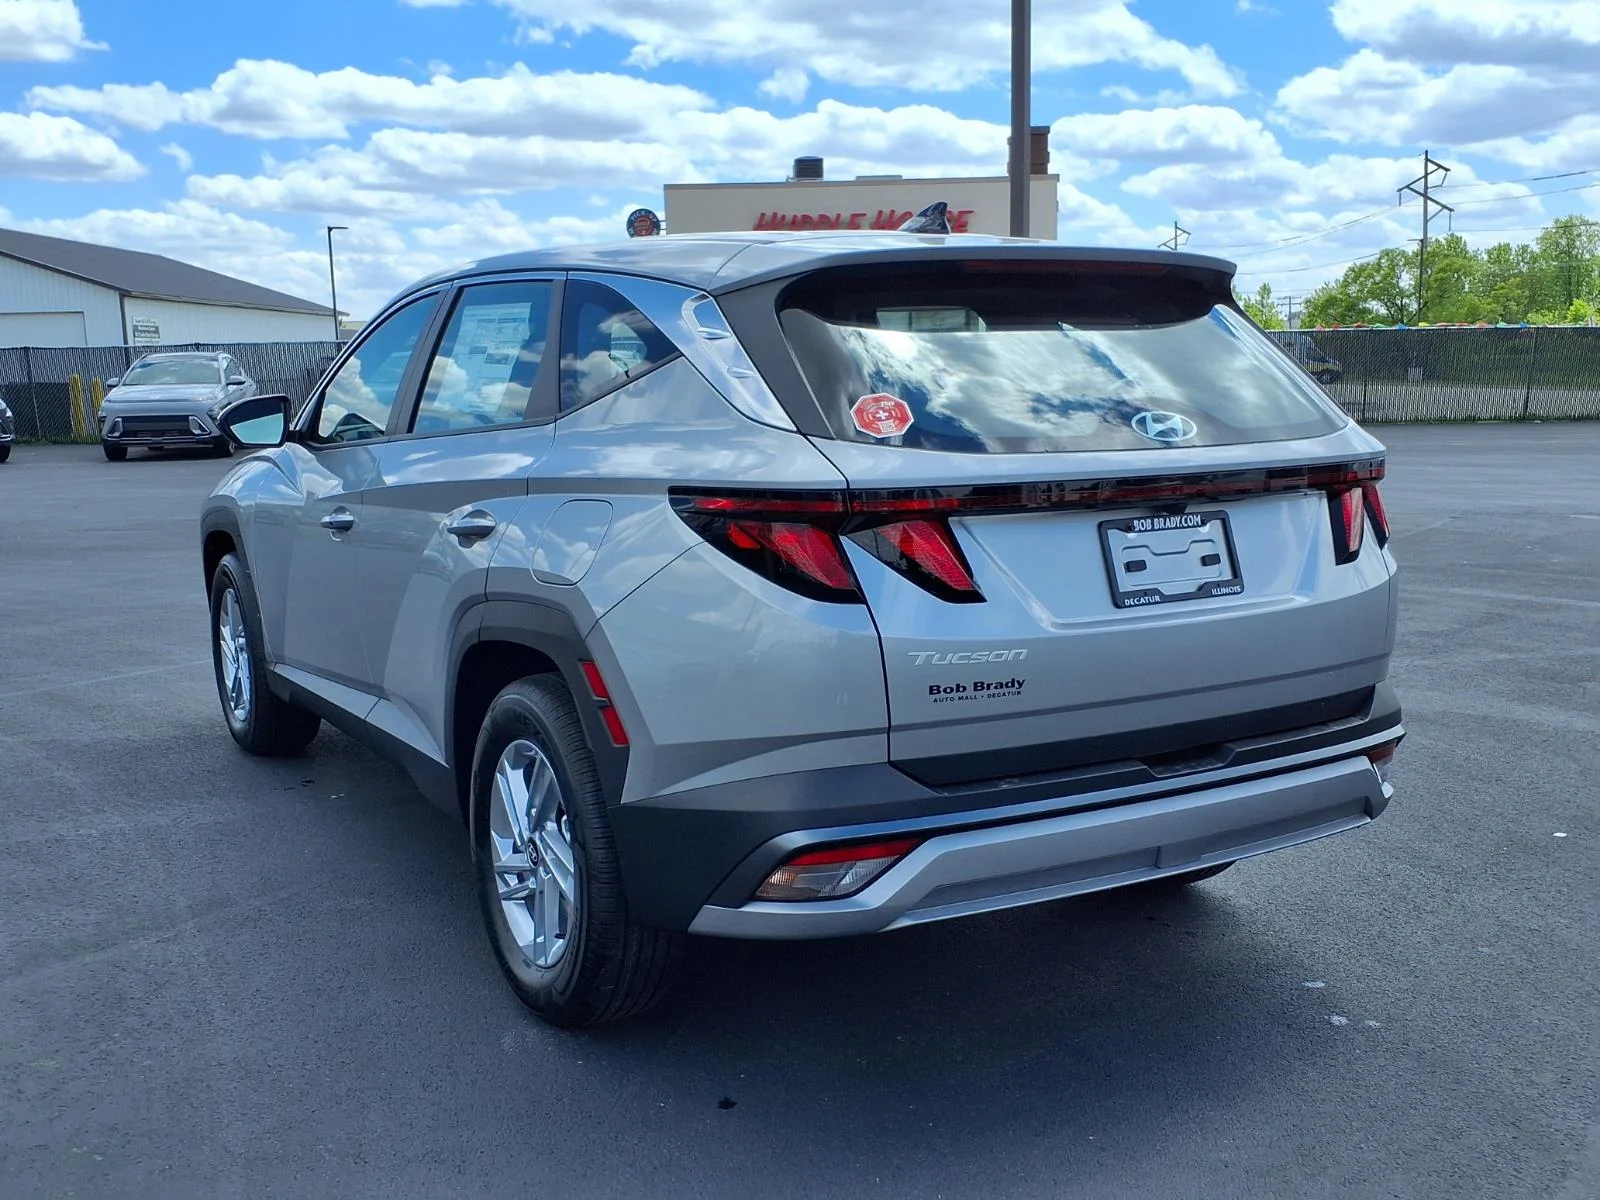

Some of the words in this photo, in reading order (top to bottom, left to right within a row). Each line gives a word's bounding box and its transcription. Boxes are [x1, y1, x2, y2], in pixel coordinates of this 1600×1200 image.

[1133, 519, 1152, 531] BOB
[1154, 514, 1201, 530] BRADY.COM
[1211, 586, 1241, 595] ILLINOIS
[1124, 595, 1161, 606] DECATUR
[907, 649, 1028, 666] TUCSON
[928, 683, 967, 695] Bob
[973, 678, 1026, 692] Brady
[987, 691, 1022, 699] DECATUR
